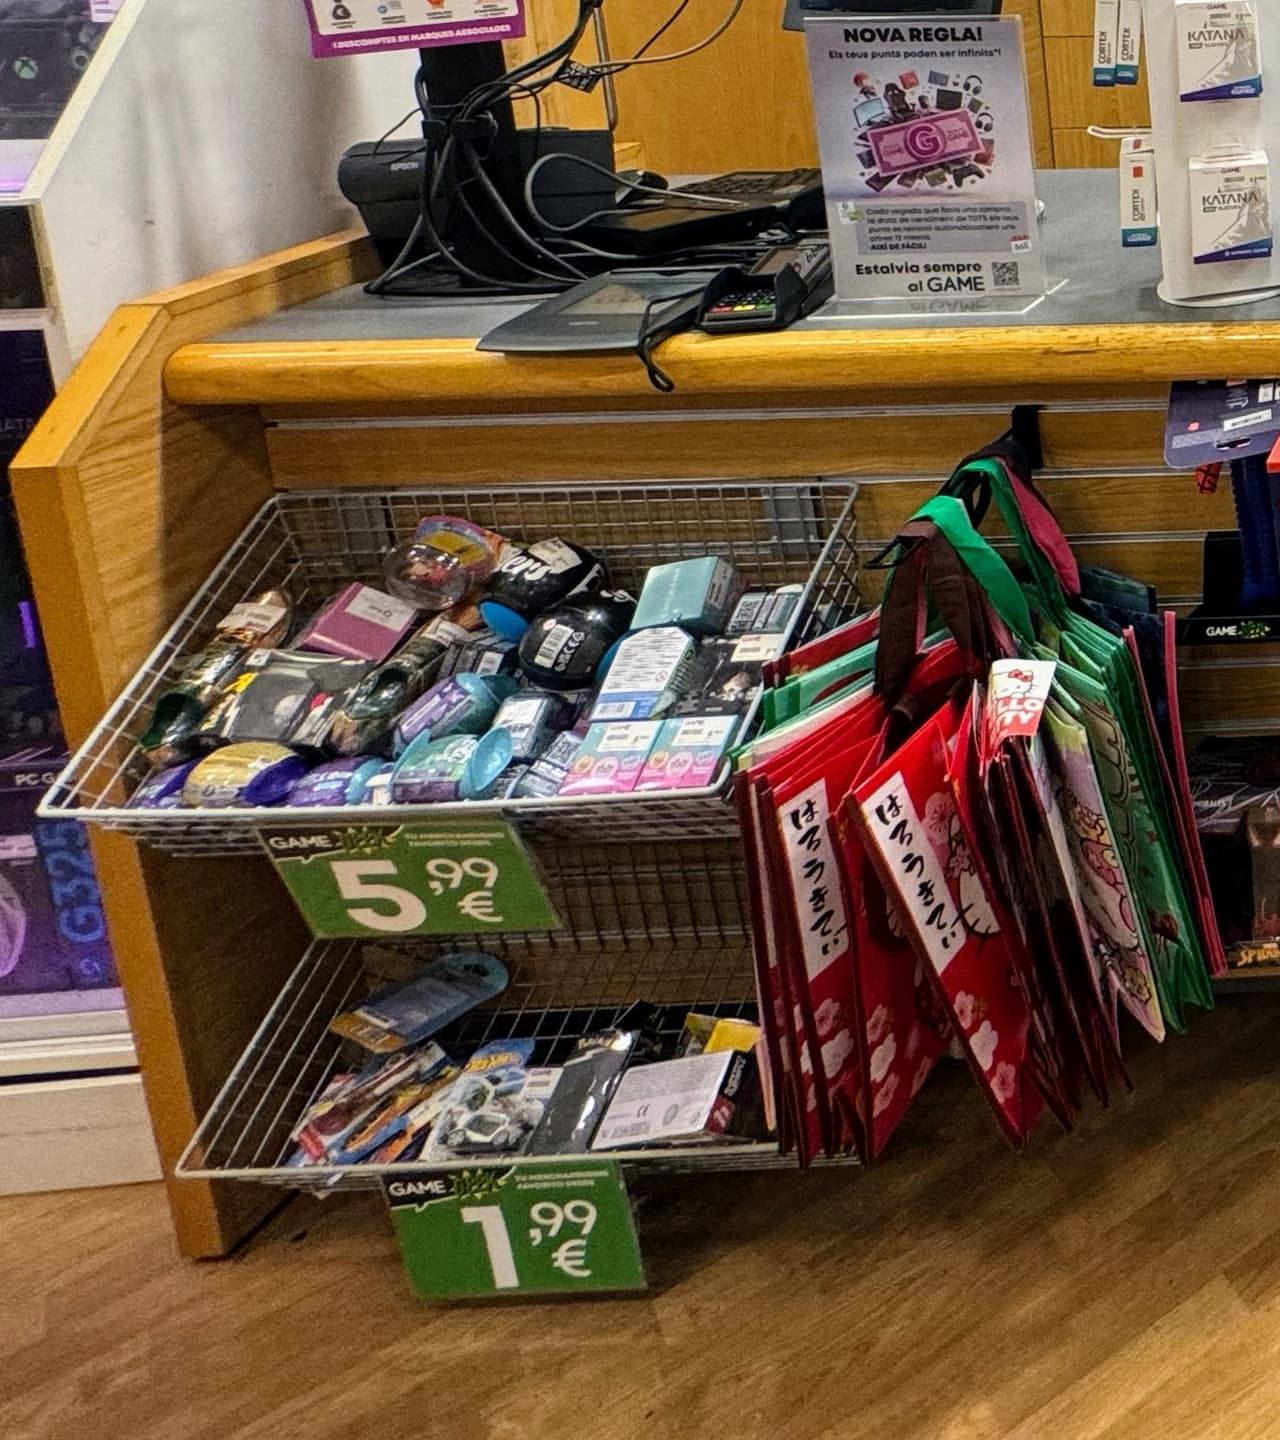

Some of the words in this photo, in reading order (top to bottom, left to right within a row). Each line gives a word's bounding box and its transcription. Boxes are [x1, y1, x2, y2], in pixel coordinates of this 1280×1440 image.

[843, 28, 905, 43] NOVA
[909, 26, 983, 42] REGLA!
[1187, 28, 1247, 42] KATANA
[829, 50, 844, 59] Els
[871, 50, 902, 60] punts
[903, 49, 938, 60] poden
[939, 50, 956, 58] ser
[1201, 191, 1259, 206] KATANA
[856, 262, 920, 275] Estalvia
[923, 262, 982, 276] sempre
[908, 278, 924, 293] al
[927, 275, 985, 293] GAME
[1206, 625, 1238, 636] GAME
[268, 835, 333, 850] GAME
[388, 1180, 446, 1197] GAME
